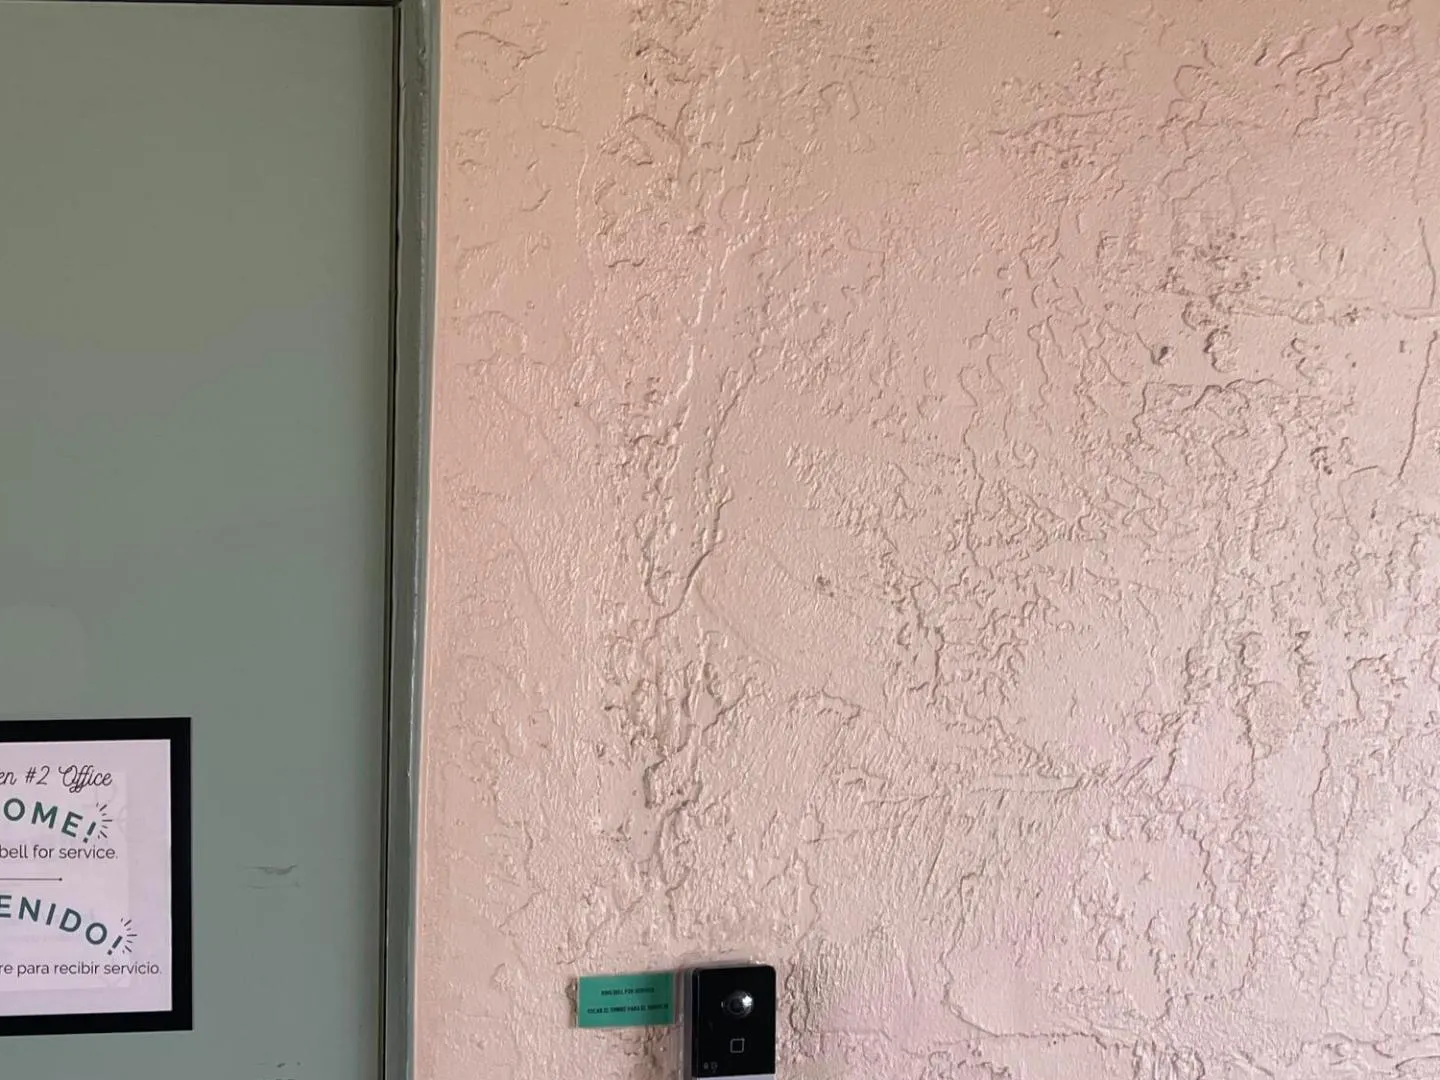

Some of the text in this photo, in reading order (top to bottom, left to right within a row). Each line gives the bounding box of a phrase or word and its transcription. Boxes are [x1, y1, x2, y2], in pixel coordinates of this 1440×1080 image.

[25, 764, 52, 786] #2
[57, 763, 114, 793] Office
[32, 843, 55, 860] for
[57, 846, 119, 861] service.
[16, 963, 50, 980] para
[53, 959, 101, 976] recibir
[103, 959, 163, 977] servicio.
